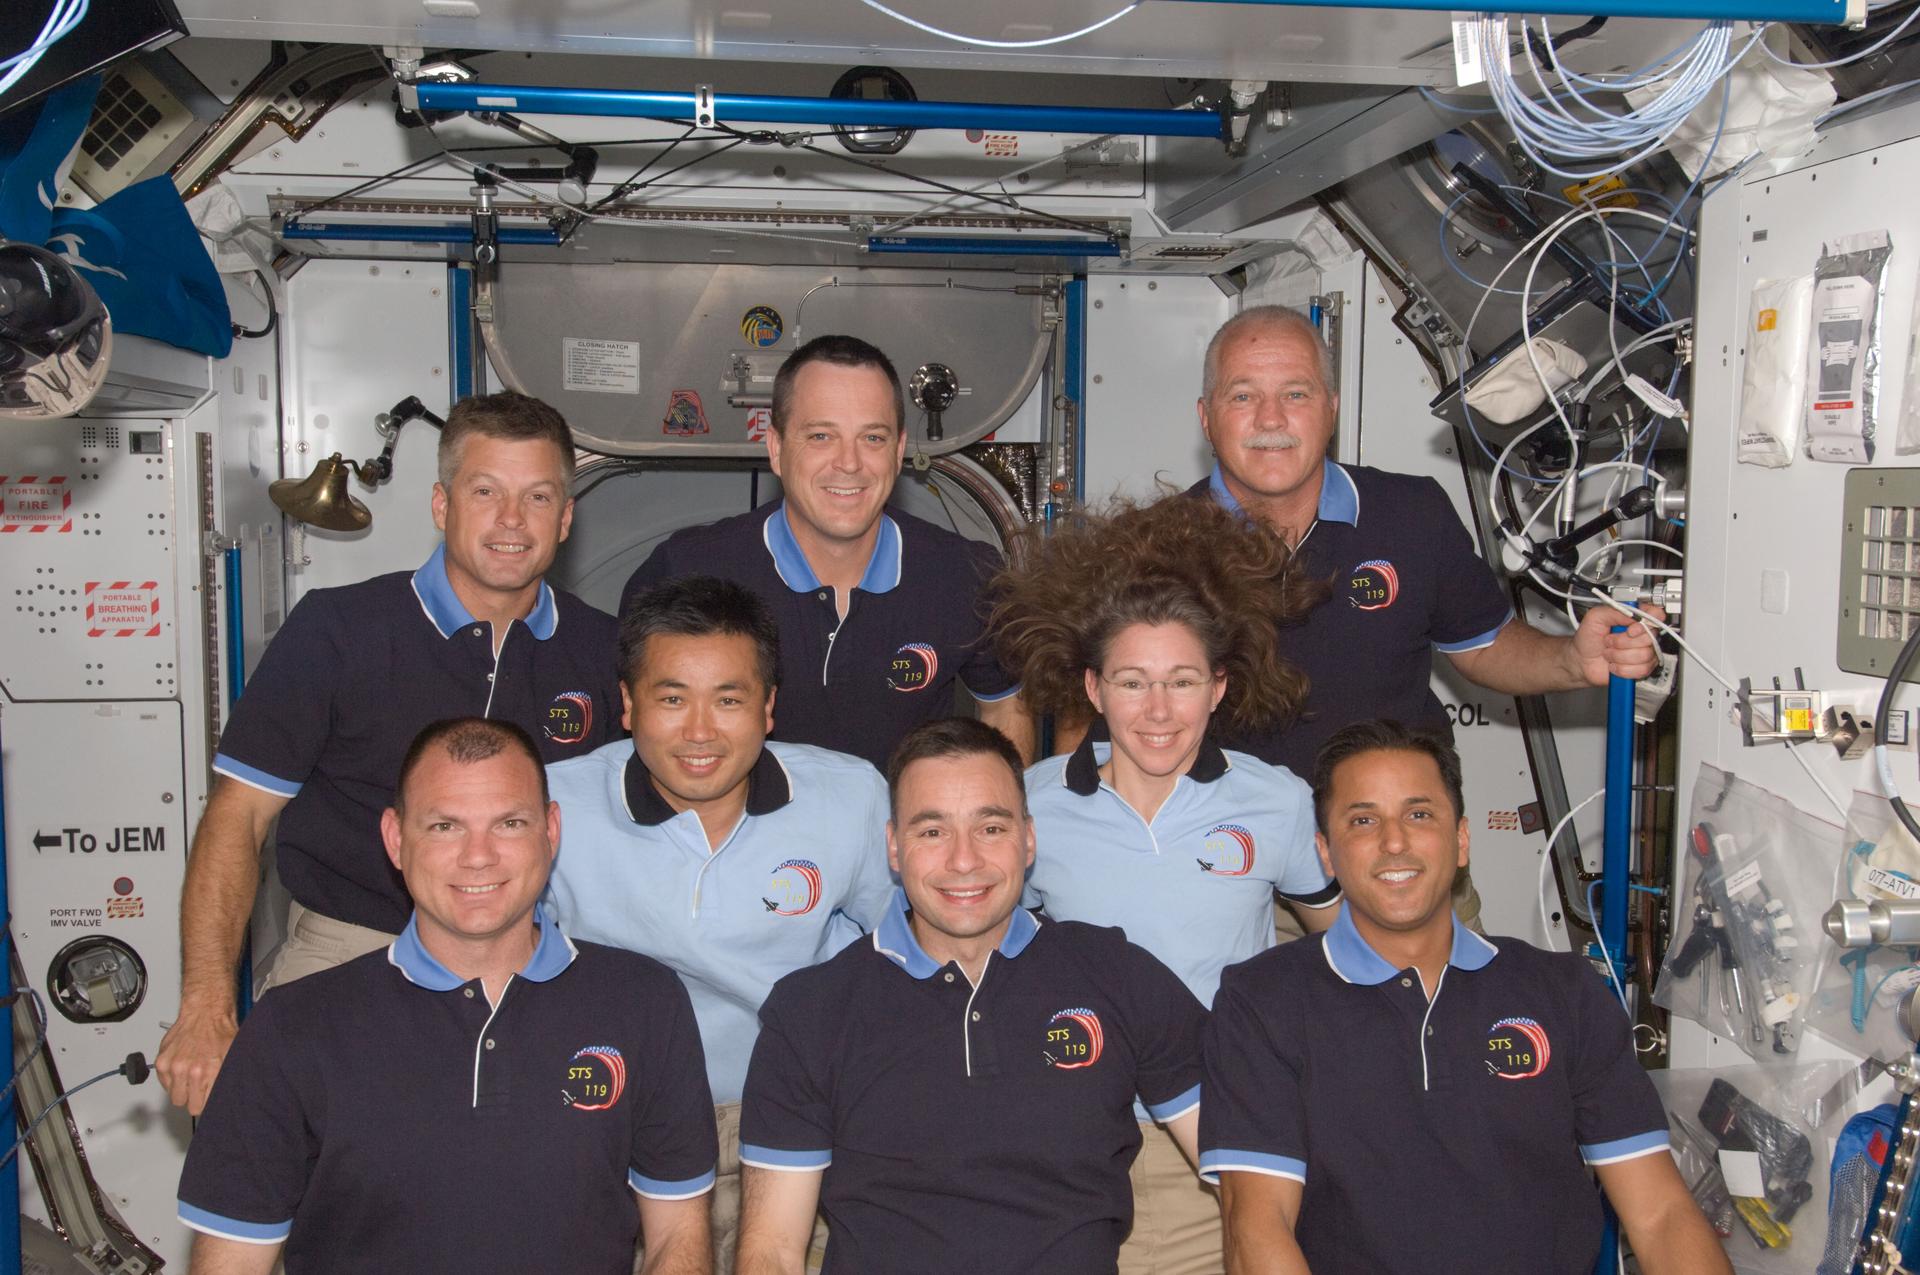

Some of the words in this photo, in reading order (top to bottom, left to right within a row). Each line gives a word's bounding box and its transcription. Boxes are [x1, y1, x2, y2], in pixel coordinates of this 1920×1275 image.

[577, 341, 606, 349] CLOSING
[8, 488, 58, 496] PORTABLE
[19, 501, 49, 510] FIRE
[1352, 577, 1370, 588] STS
[1366, 589, 1384, 599] 119
[98, 605, 148, 613] BREATHING
[892, 660, 911, 670] STS
[905, 672, 922, 682] 119
[549, 708, 569, 718] STS
[562, 722, 580, 732] 119
[62, 828, 97, 853] To
[105, 826, 165, 853] JEM
[1868, 869, 1916, 898] 077-ATV1
[50, 908, 76, 917] PORT
[80, 908, 102, 917] FWD
[50, 919, 68, 927] IMV
[71, 919, 102, 927] VALVE
[1047, 1028, 1070, 1041] STS
[1064, 1043, 1087, 1056] 119
[1488, 1038, 1512, 1051] STS
[1507, 1053, 1531, 1066] 119
[568, 1067, 592, 1079] STS
[585, 1084, 607, 1096] 119
